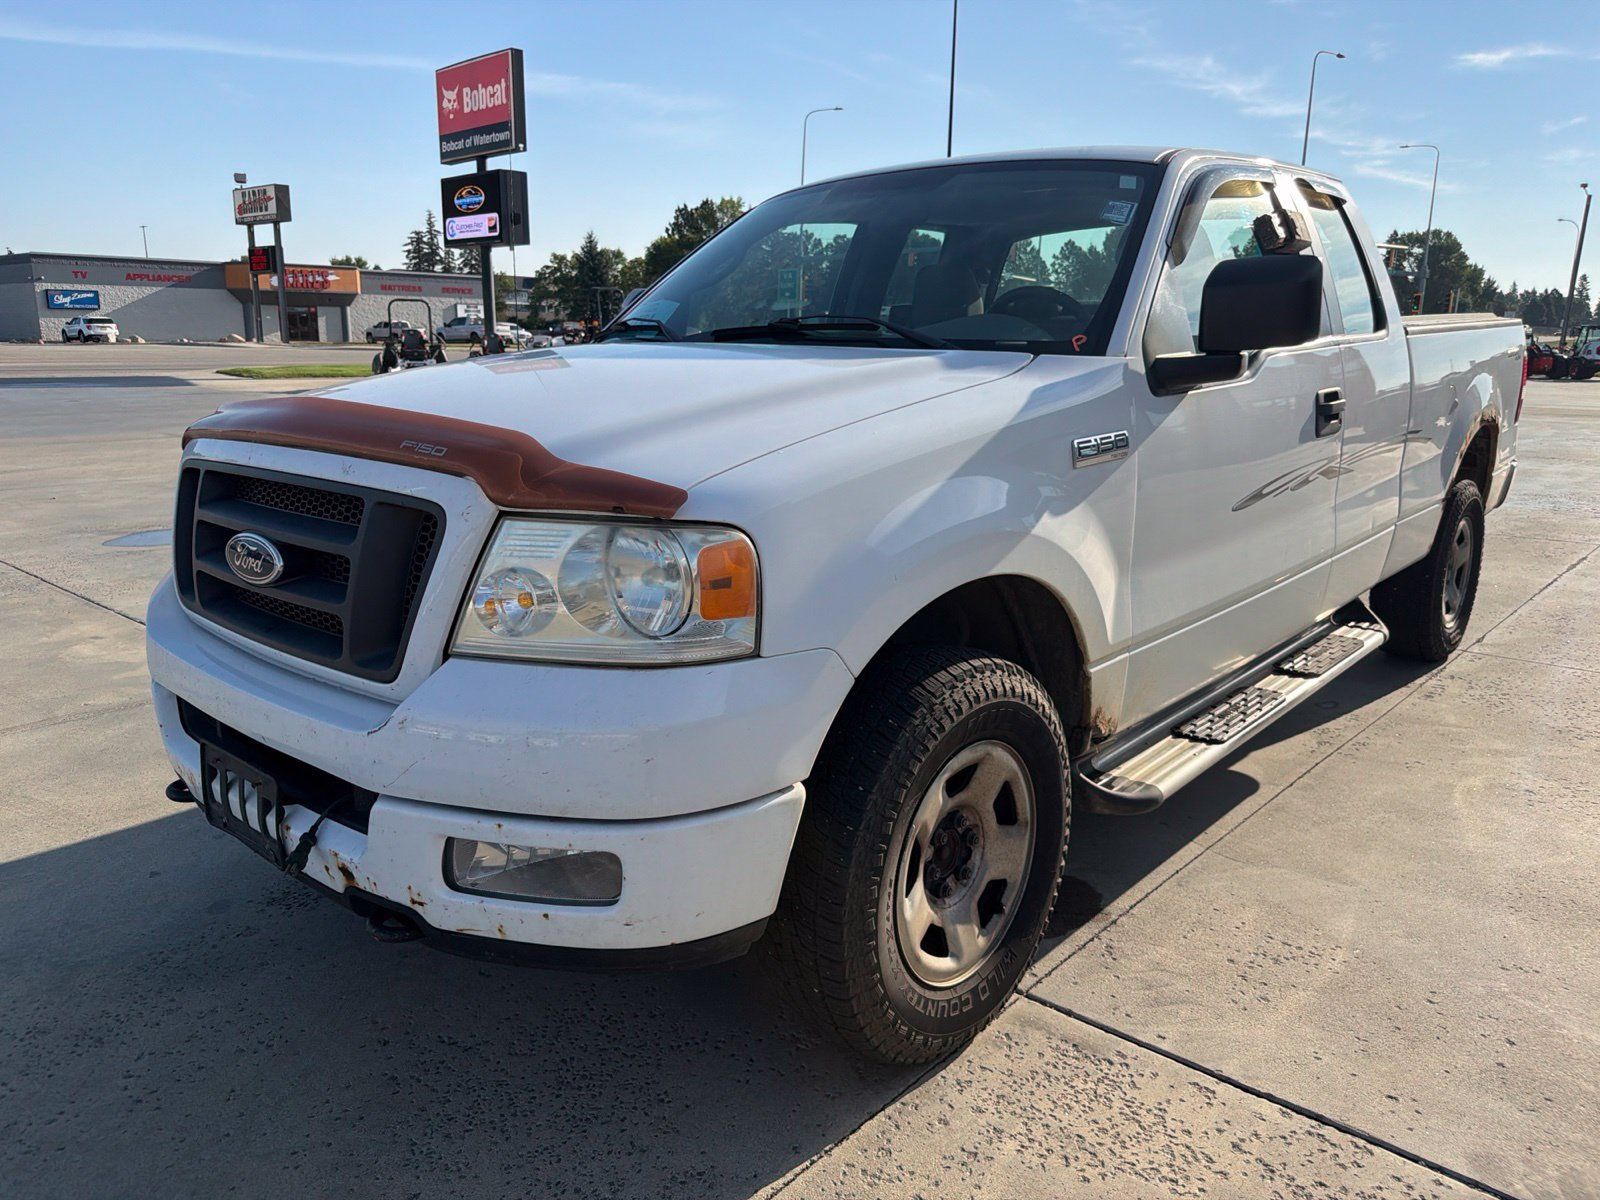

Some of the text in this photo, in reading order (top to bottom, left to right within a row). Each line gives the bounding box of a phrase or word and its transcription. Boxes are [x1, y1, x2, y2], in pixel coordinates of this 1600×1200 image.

[462, 78, 507, 114] Bobcat
[441, 130, 511, 153] Bobcat of Watertown
[71, 270, 88, 279] TV
[125, 272, 193, 283] APPLIANCES
[380, 283, 422, 293] MATTRESS
[441, 286, 474, 294] SERVICE
[232, 540, 264, 573] Ford
[899, 946, 1019, 1019] WILD COUNTRY
